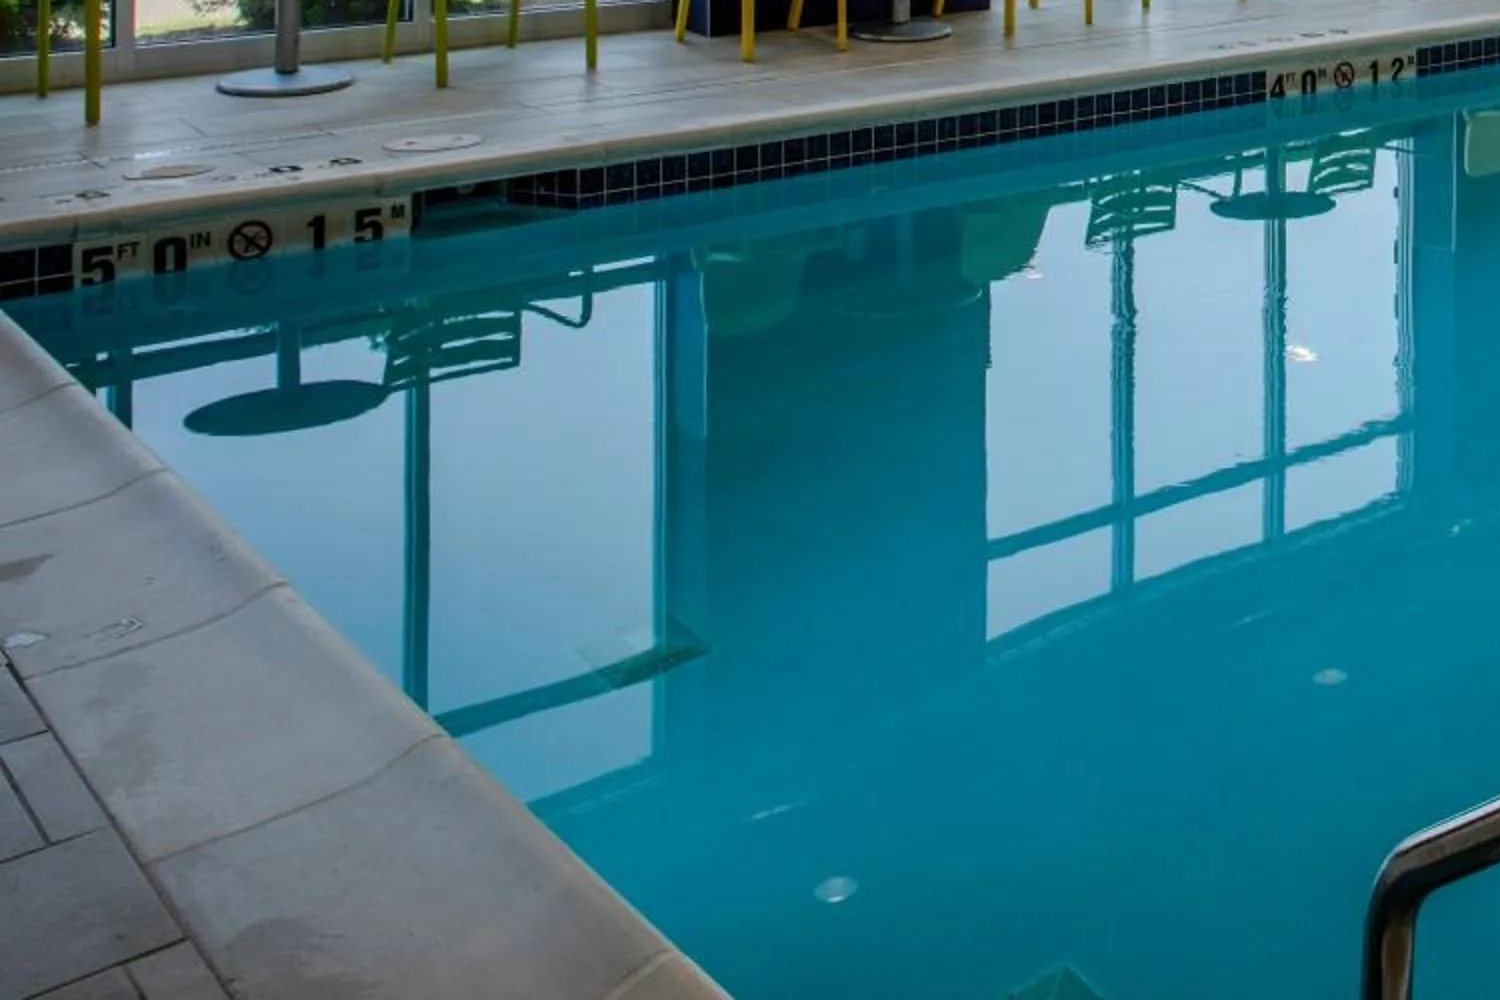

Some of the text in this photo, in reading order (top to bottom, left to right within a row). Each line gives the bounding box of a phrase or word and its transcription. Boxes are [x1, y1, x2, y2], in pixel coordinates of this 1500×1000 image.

[1270, 73, 1285, 98] 4
[81, 246, 115, 286] 5
[153, 236, 187, 274] 0
[354, 208, 383, 243] 5
